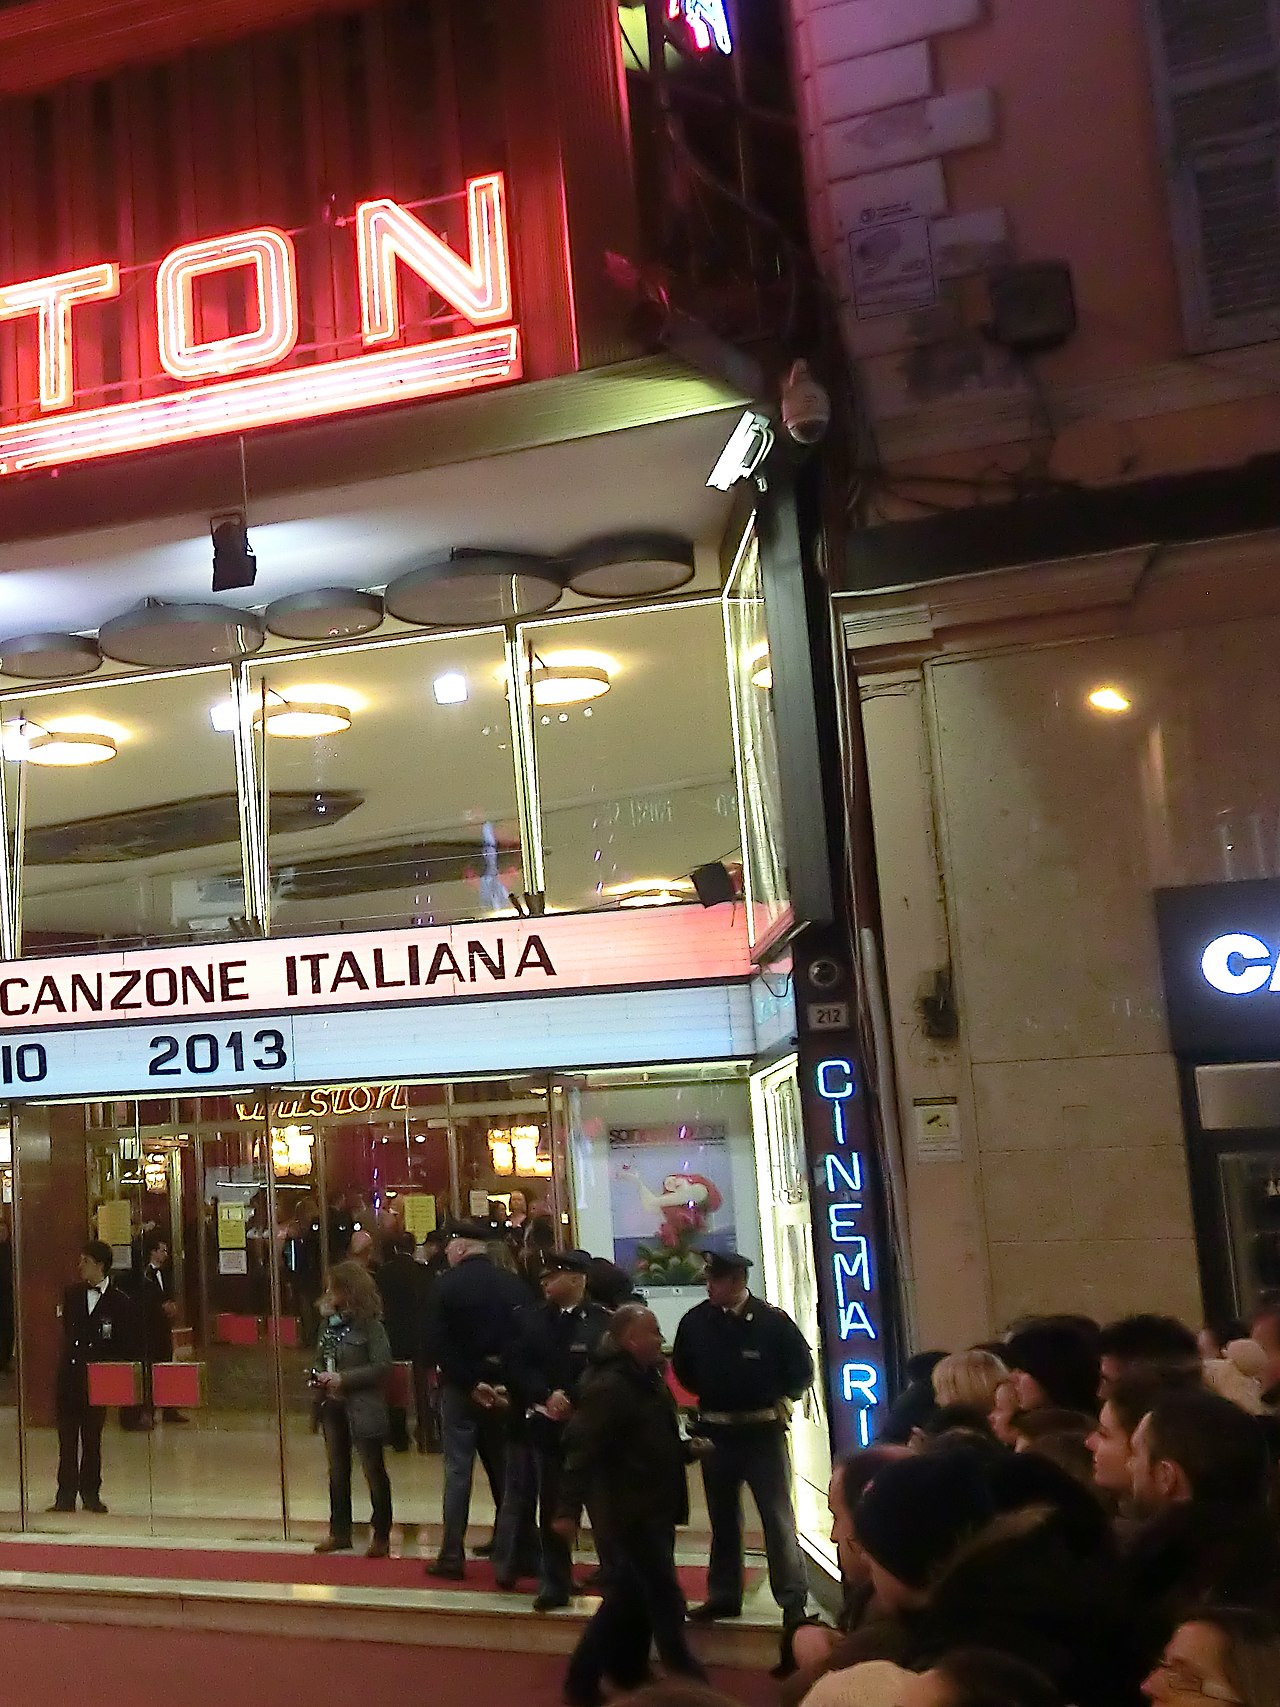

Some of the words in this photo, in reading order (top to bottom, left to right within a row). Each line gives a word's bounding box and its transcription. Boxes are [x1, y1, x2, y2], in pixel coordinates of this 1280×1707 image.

[0, 961, 249, 1017] CANZONE
[286, 934, 558, 997] ITALIANA
[1201, 932, 1280, 995] C
[816, 1007, 841, 1025] 212
[148, 1029, 288, 1076] 2013
[816, 1059, 876, 1340] CINEMA
